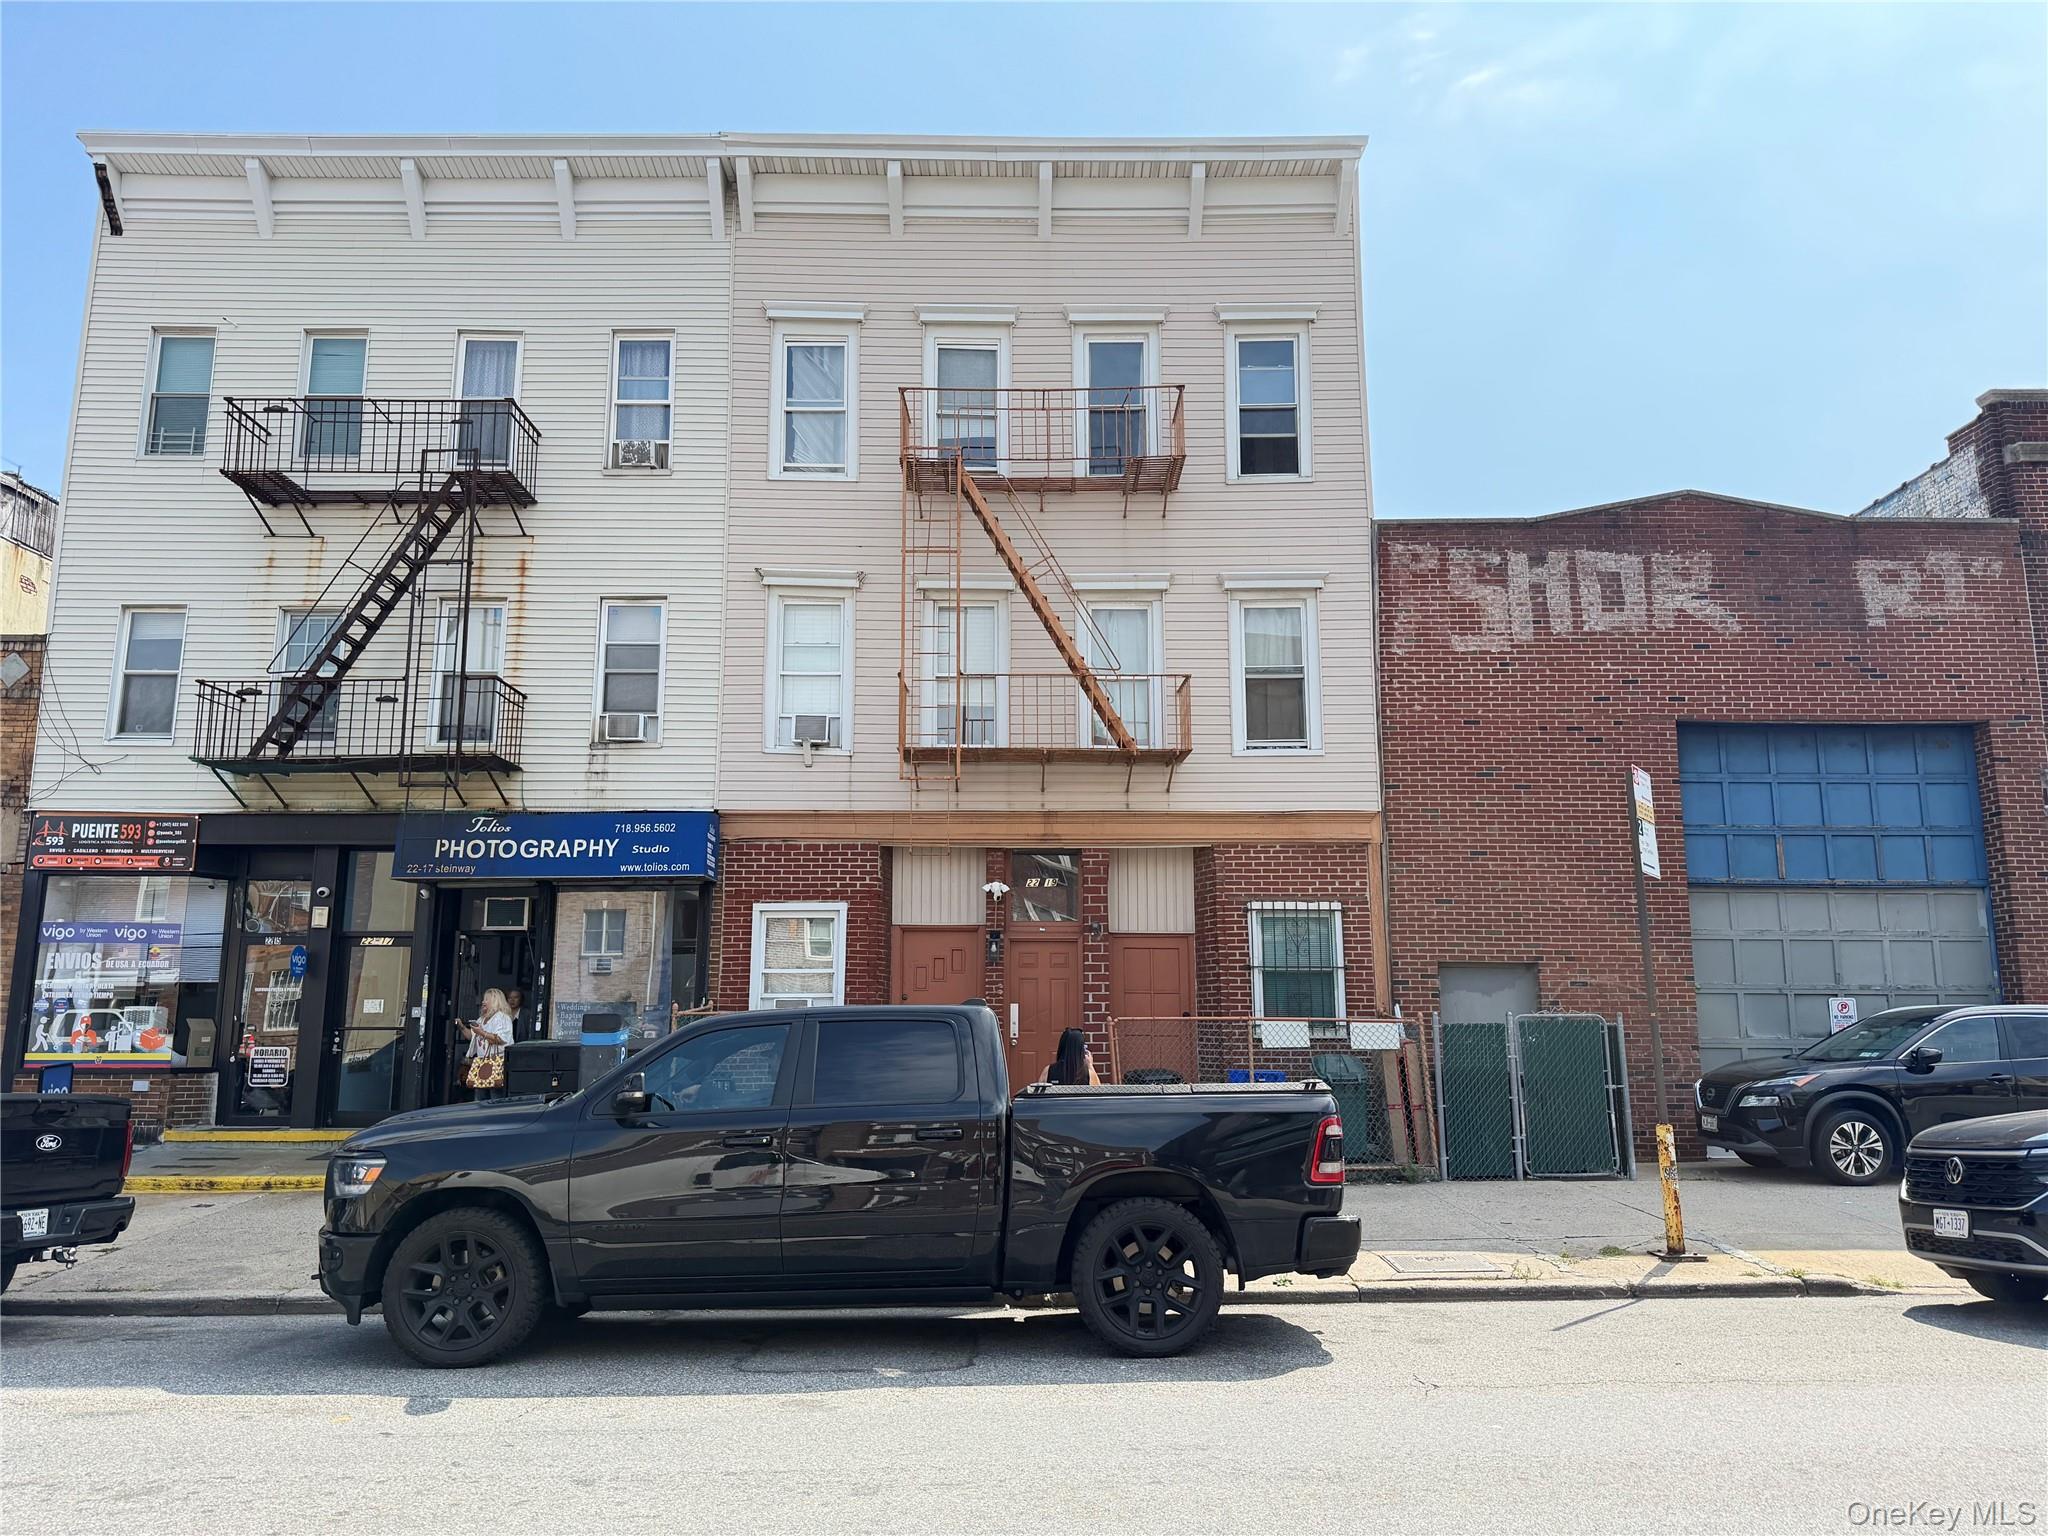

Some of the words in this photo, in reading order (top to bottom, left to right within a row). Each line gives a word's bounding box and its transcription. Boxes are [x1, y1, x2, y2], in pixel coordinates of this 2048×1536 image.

[465, 816, 512, 833] Tolios
[615, 823, 676, 833] 718.956.5602
[71, 823, 119, 839] PUENTE
[120, 824, 142, 839] 593
[45, 836, 64, 846] 593
[434, 838, 619, 859] PHOTOGRAPHY
[632, 844, 670, 854] Studio
[406, 864, 433, 873] 22-17
[435, 864, 476, 874] steinway
[620, 862, 690, 872] www.tolios.com
[1026, 879, 1040, 888] 22
[42, 924, 76, 941] vigo
[114, 925, 148, 942] vigo
[291, 951, 307, 967] vigo
[560, 1011, 584, 1020] Baptis
[253, 1049, 288, 1057] HORARIO
